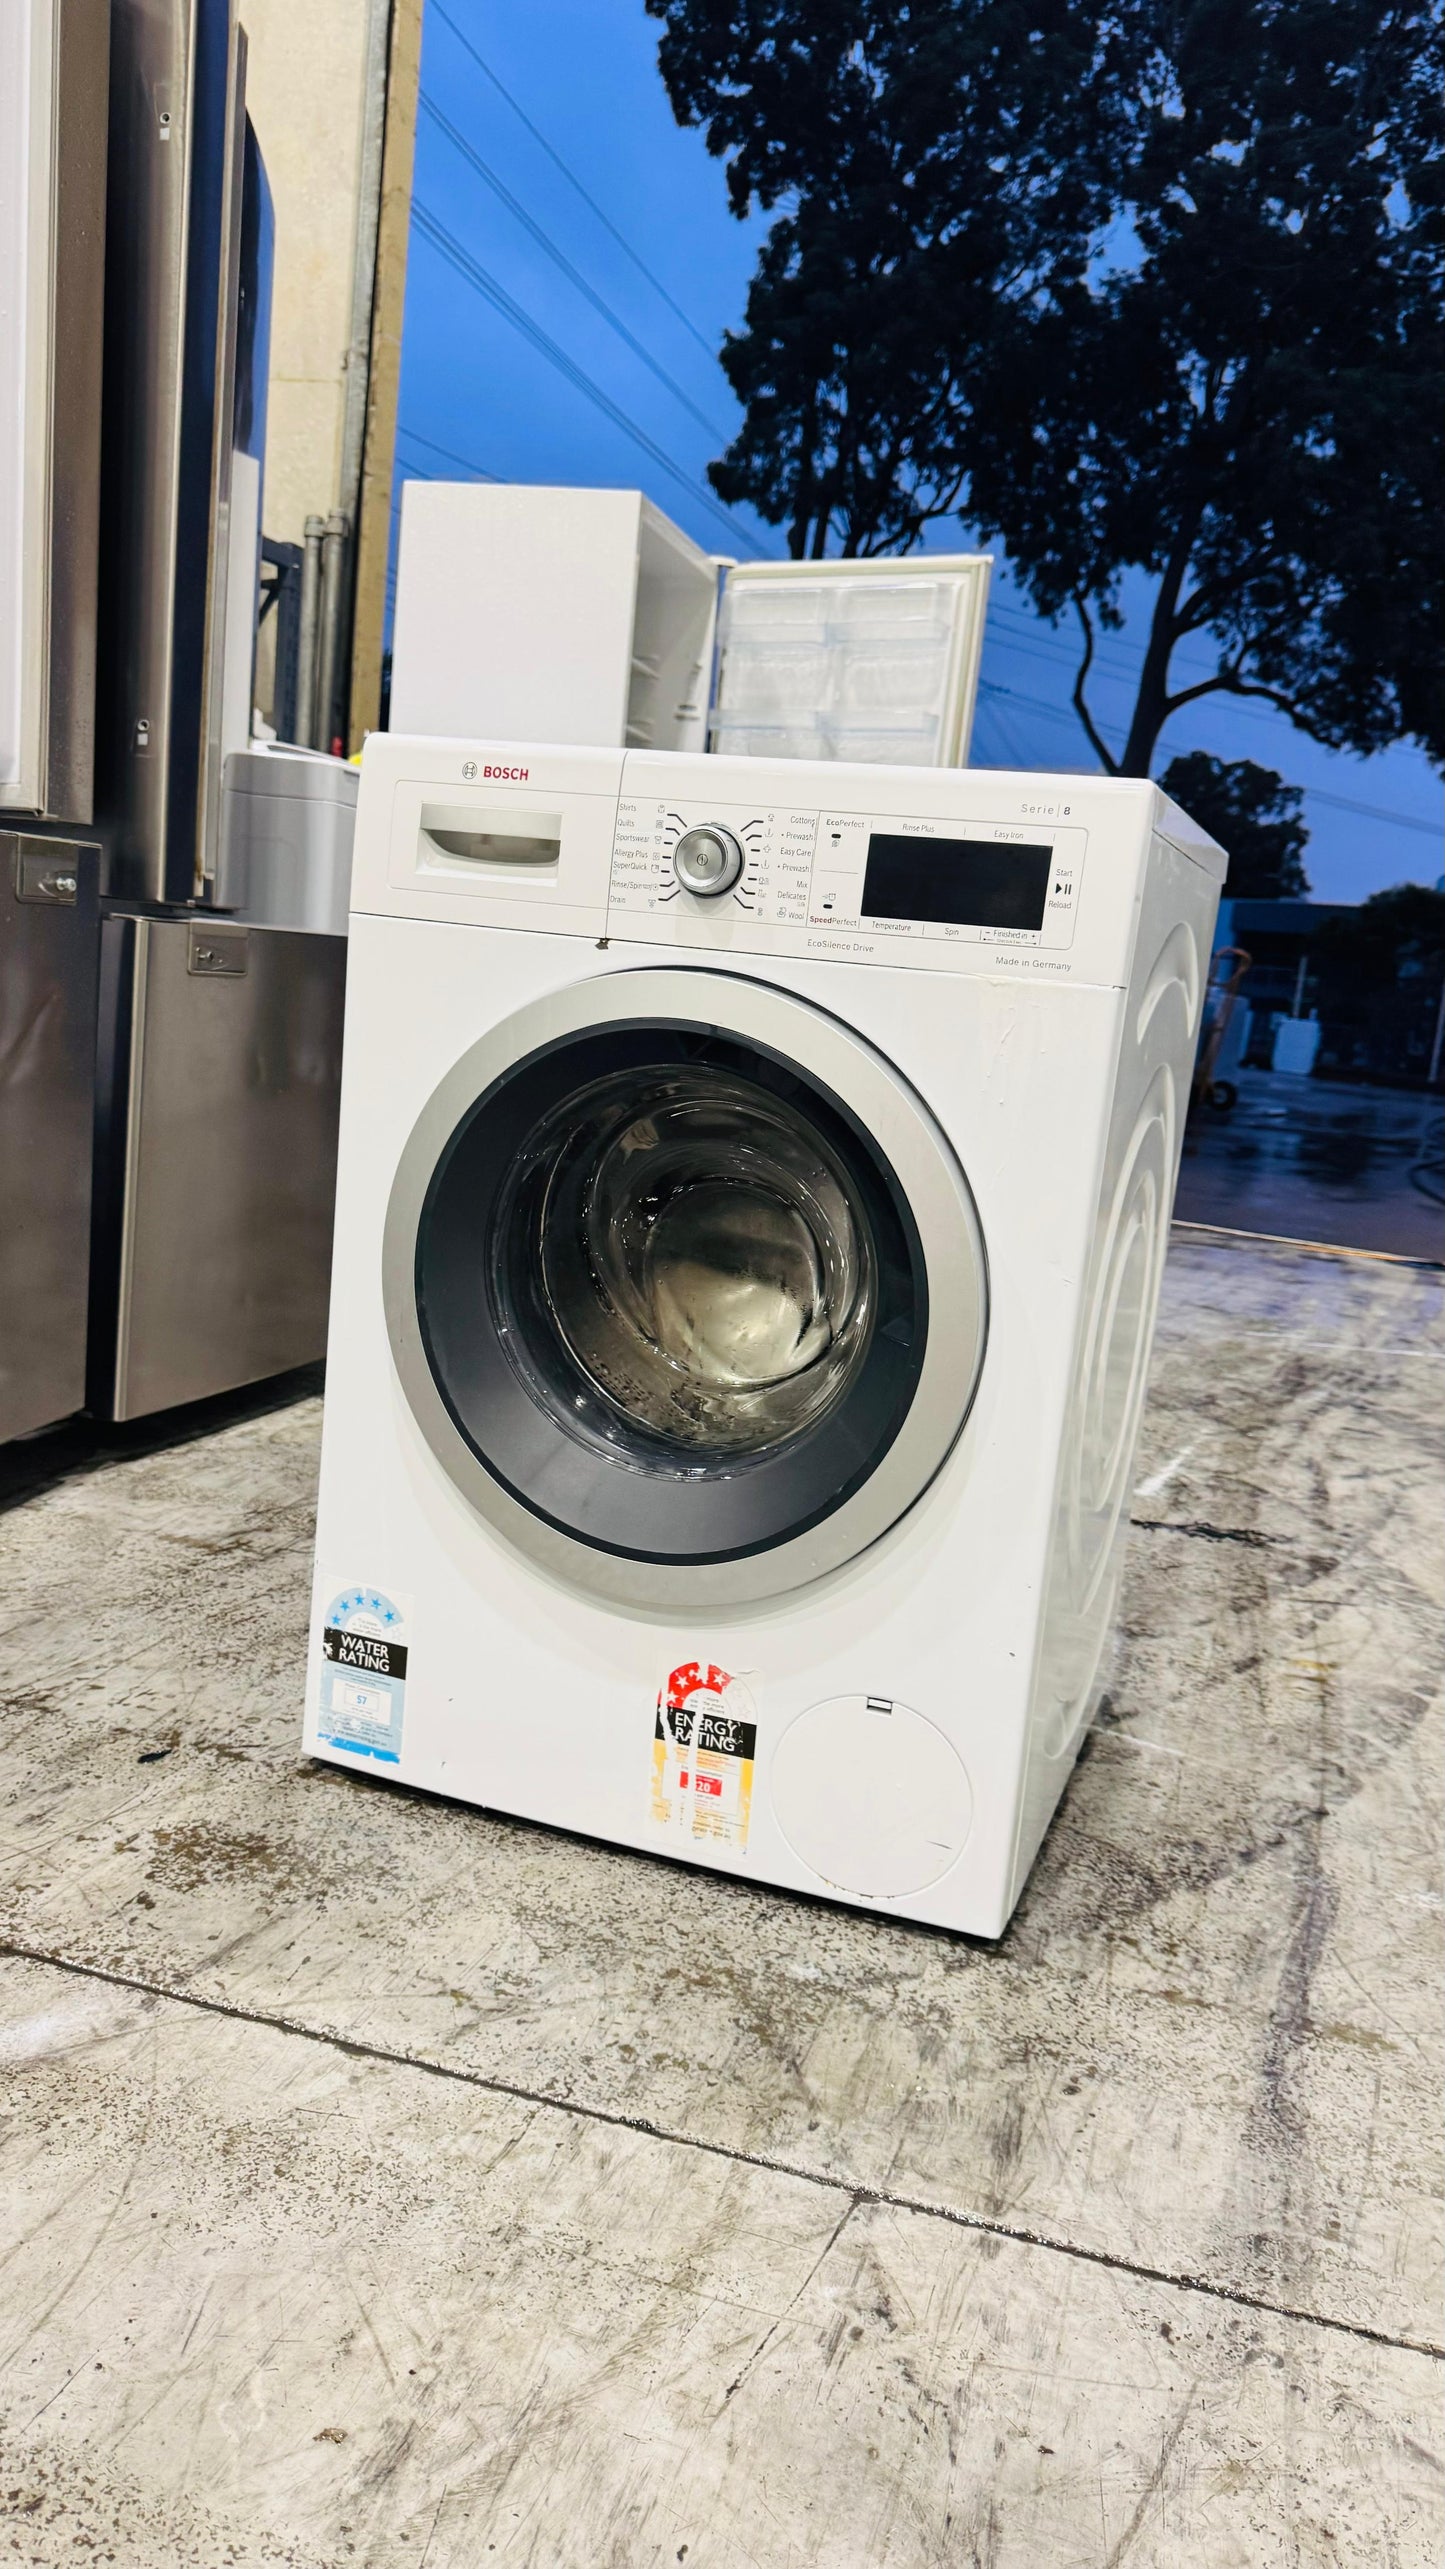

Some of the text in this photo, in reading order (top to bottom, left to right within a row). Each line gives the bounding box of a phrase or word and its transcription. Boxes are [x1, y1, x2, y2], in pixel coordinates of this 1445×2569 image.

[484, 766, 529, 781] BOSCH
[1021, 804, 1071, 816] Serie 8
[617, 819, 635, 828] Quilts
[826, 818, 865, 828] EcoPerfect
[902, 823, 935, 833] Rinse Plus
[616, 833, 650, 843] Sportswear
[786, 831, 813, 841] Prewash
[994, 830, 1024, 840] Easy Iron
[614, 849, 648, 859] Allergy Plus
[780, 847, 811, 857] Easy Care
[613, 861, 647, 871] SuperQuick
[782, 863, 810, 873] Prewash
[1055, 868, 1073, 877] Start
[796, 880, 808, 888] Mix
[777, 890, 806, 901] Delicates
[1048, 900, 1072, 909] Reload
[788, 911, 805, 920] Wool
[809, 915, 857, 927] SpeedPerfect
[872, 920, 911, 932] Temperature
[944, 927, 959, 936] Spin
[993, 929, 1021, 939] Finished
[807, 939, 874, 952] EcoSilence Drive
[996, 956, 1072, 971] Made in Germany
[341, 1633, 389, 1659] WATER
[338, 1647, 390, 1673] RATING
